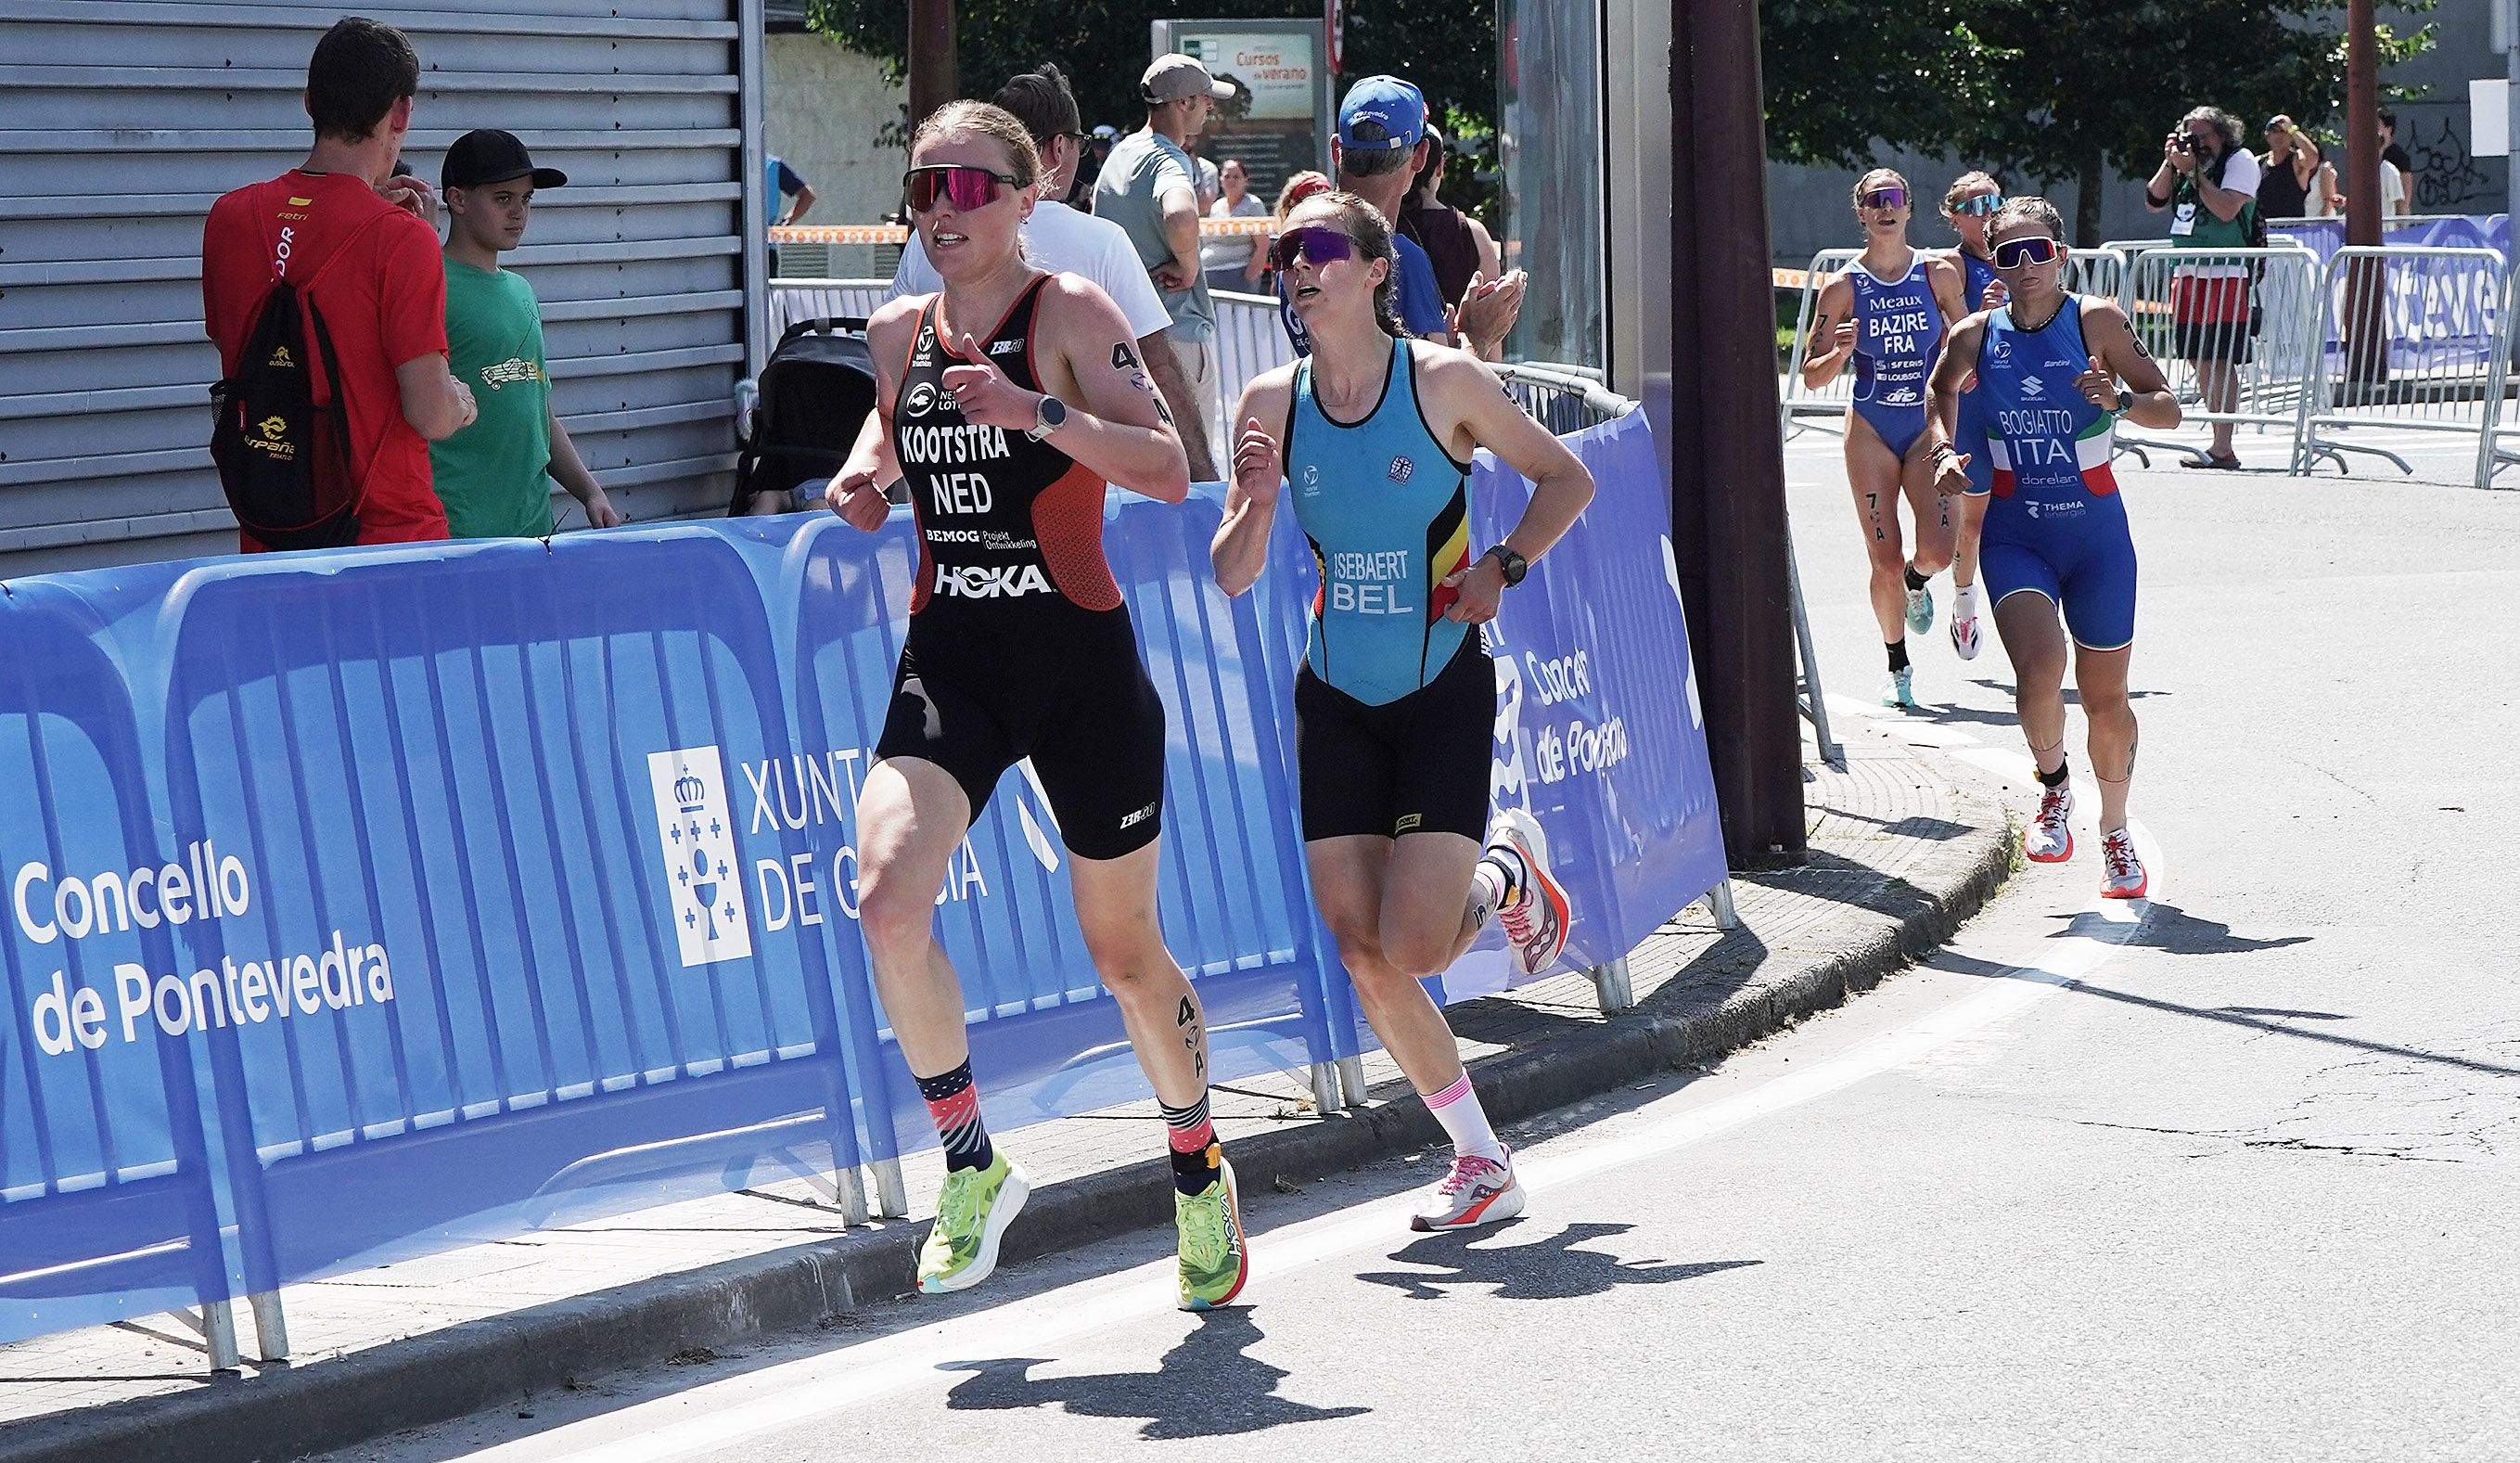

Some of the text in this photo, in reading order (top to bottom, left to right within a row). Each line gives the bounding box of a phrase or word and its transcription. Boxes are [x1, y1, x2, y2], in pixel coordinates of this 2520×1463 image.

[1235, 52, 1280, 66] Cursos
[1262, 68, 1307, 80] verano
[274, 226, 295, 279] DOR
[1870, 294, 1924, 311] Meaux
[1818, 314, 1828, 329] 7
[1869, 311, 1929, 338] BAZIRE
[1111, 341, 1139, 369] 4
[1884, 335, 1916, 354] FRA
[1890, 359, 1925, 370] SFERIS
[940, 391, 956, 401] NE
[1999, 409, 2073, 435] BOGIATTO
[902, 423, 1011, 463] KOOTSTRA
[2014, 438, 2073, 466] ITA
[2021, 471, 2079, 485] dorelan
[929, 473, 992, 516] NED
[1865, 493, 1877, 509] 7
[2042, 500, 2085, 512] THEMA
[1940, 514, 1949, 527] A
[926, 530, 980, 543] BEMOG
[983, 531, 1010, 542] Projekt
[985, 539, 1037, 551] Ontwikkeling
[1875, 527, 1885, 541] A
[1334, 550, 1408, 581] ISEBAERT
[933, 563, 1053, 599] HOKA
[1333, 582, 1414, 615] BEL
[741, 747, 875, 834] XUNT
[14, 839, 249, 944] Concello
[756, 853, 824, 932] DE
[32, 929, 395, 1056] de Pontevedra
[1176, 994, 1196, 1027] 4
